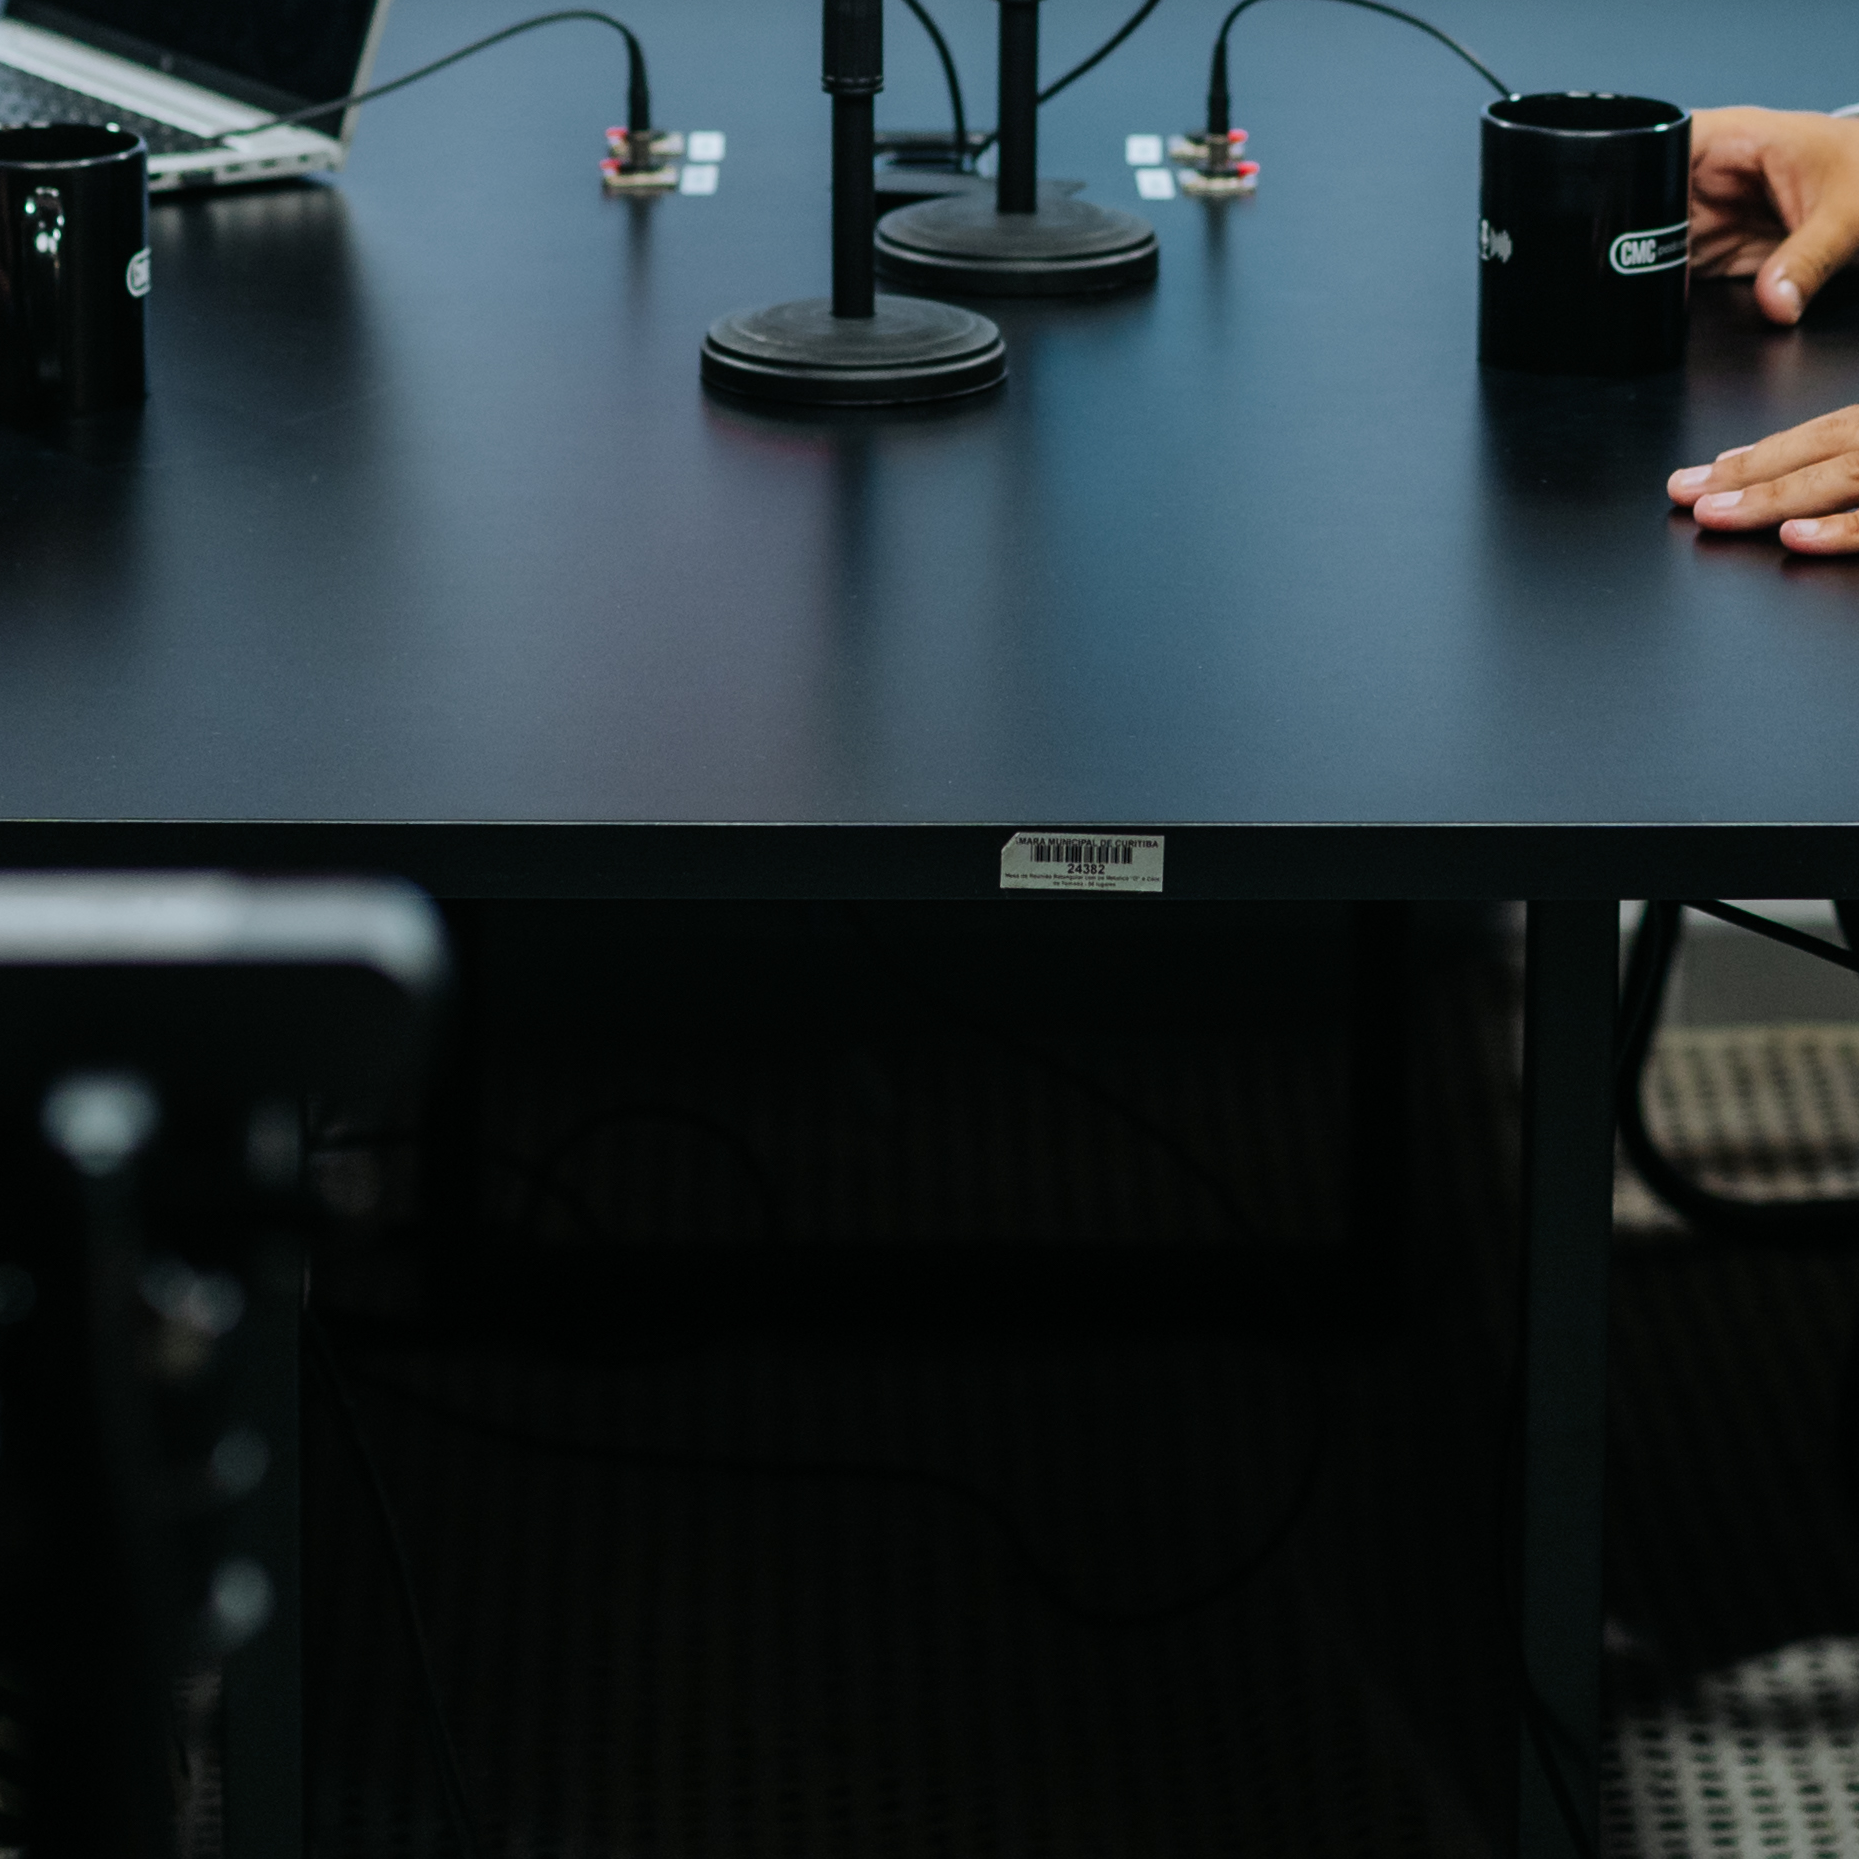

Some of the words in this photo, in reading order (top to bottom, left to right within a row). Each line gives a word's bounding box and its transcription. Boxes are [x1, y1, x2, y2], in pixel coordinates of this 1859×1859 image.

[1620, 238, 1657, 267] CMC
[1016, 837, 1046, 845] MARA
[1048, 837, 1098, 847] MUNICIPAL
[1100, 839, 1113, 847] DE
[1114, 839, 1159, 848] CURITIBA
[1067, 863, 1105, 875] 24382
